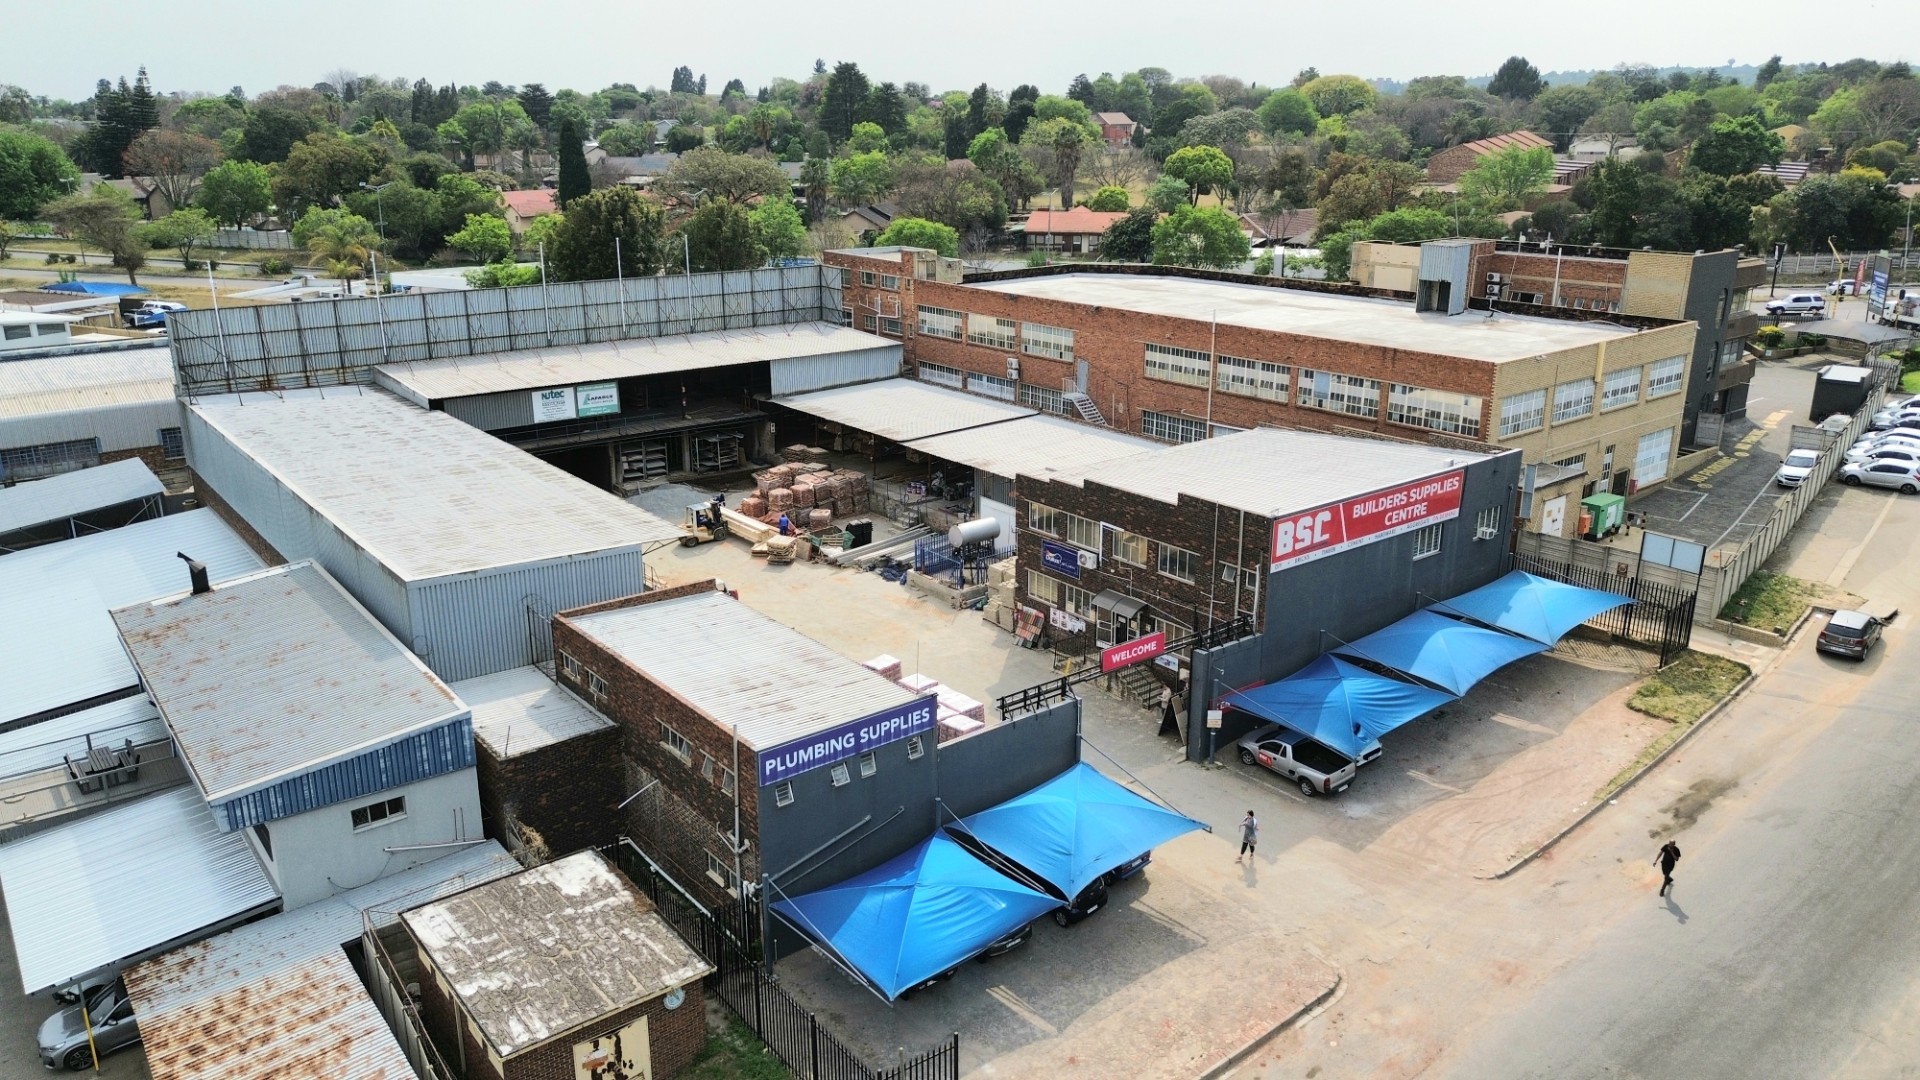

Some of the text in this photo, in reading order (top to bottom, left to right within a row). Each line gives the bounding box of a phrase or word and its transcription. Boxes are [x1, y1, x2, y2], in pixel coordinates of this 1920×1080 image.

[1352, 476, 1460, 519] BUILDERS SUPPLIES
[1384, 502, 1428, 526] CENTRE
[1275, 510, 1332, 558] BSC
[1111, 641, 1158, 664] WELCOME
[765, 707, 930, 776] PLUMBING SUPPLIES
